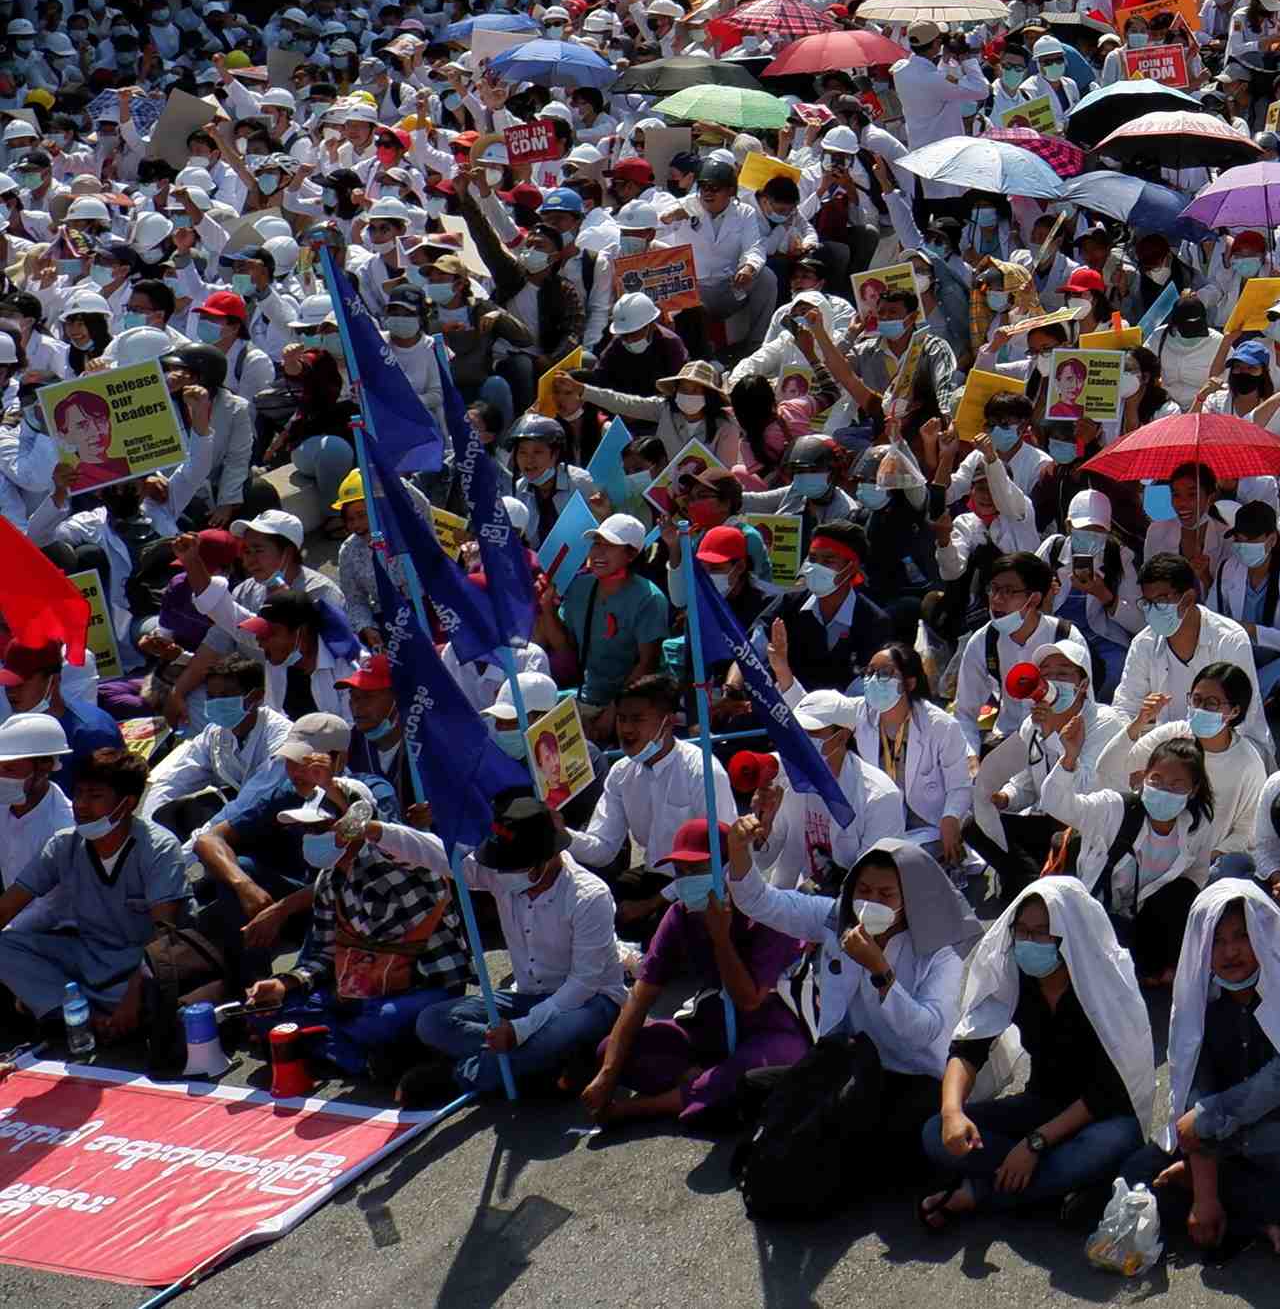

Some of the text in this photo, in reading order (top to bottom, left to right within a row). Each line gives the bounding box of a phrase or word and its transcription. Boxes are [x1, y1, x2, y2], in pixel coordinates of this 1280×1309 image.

[1138, 58, 1161, 71] JOIN
[511, 136, 549, 155] CDM
[106, 373, 159, 396] Release
[111, 395, 134, 410] our
[115, 400, 168, 424] Leaders
[129, 443, 182, 464] Government
